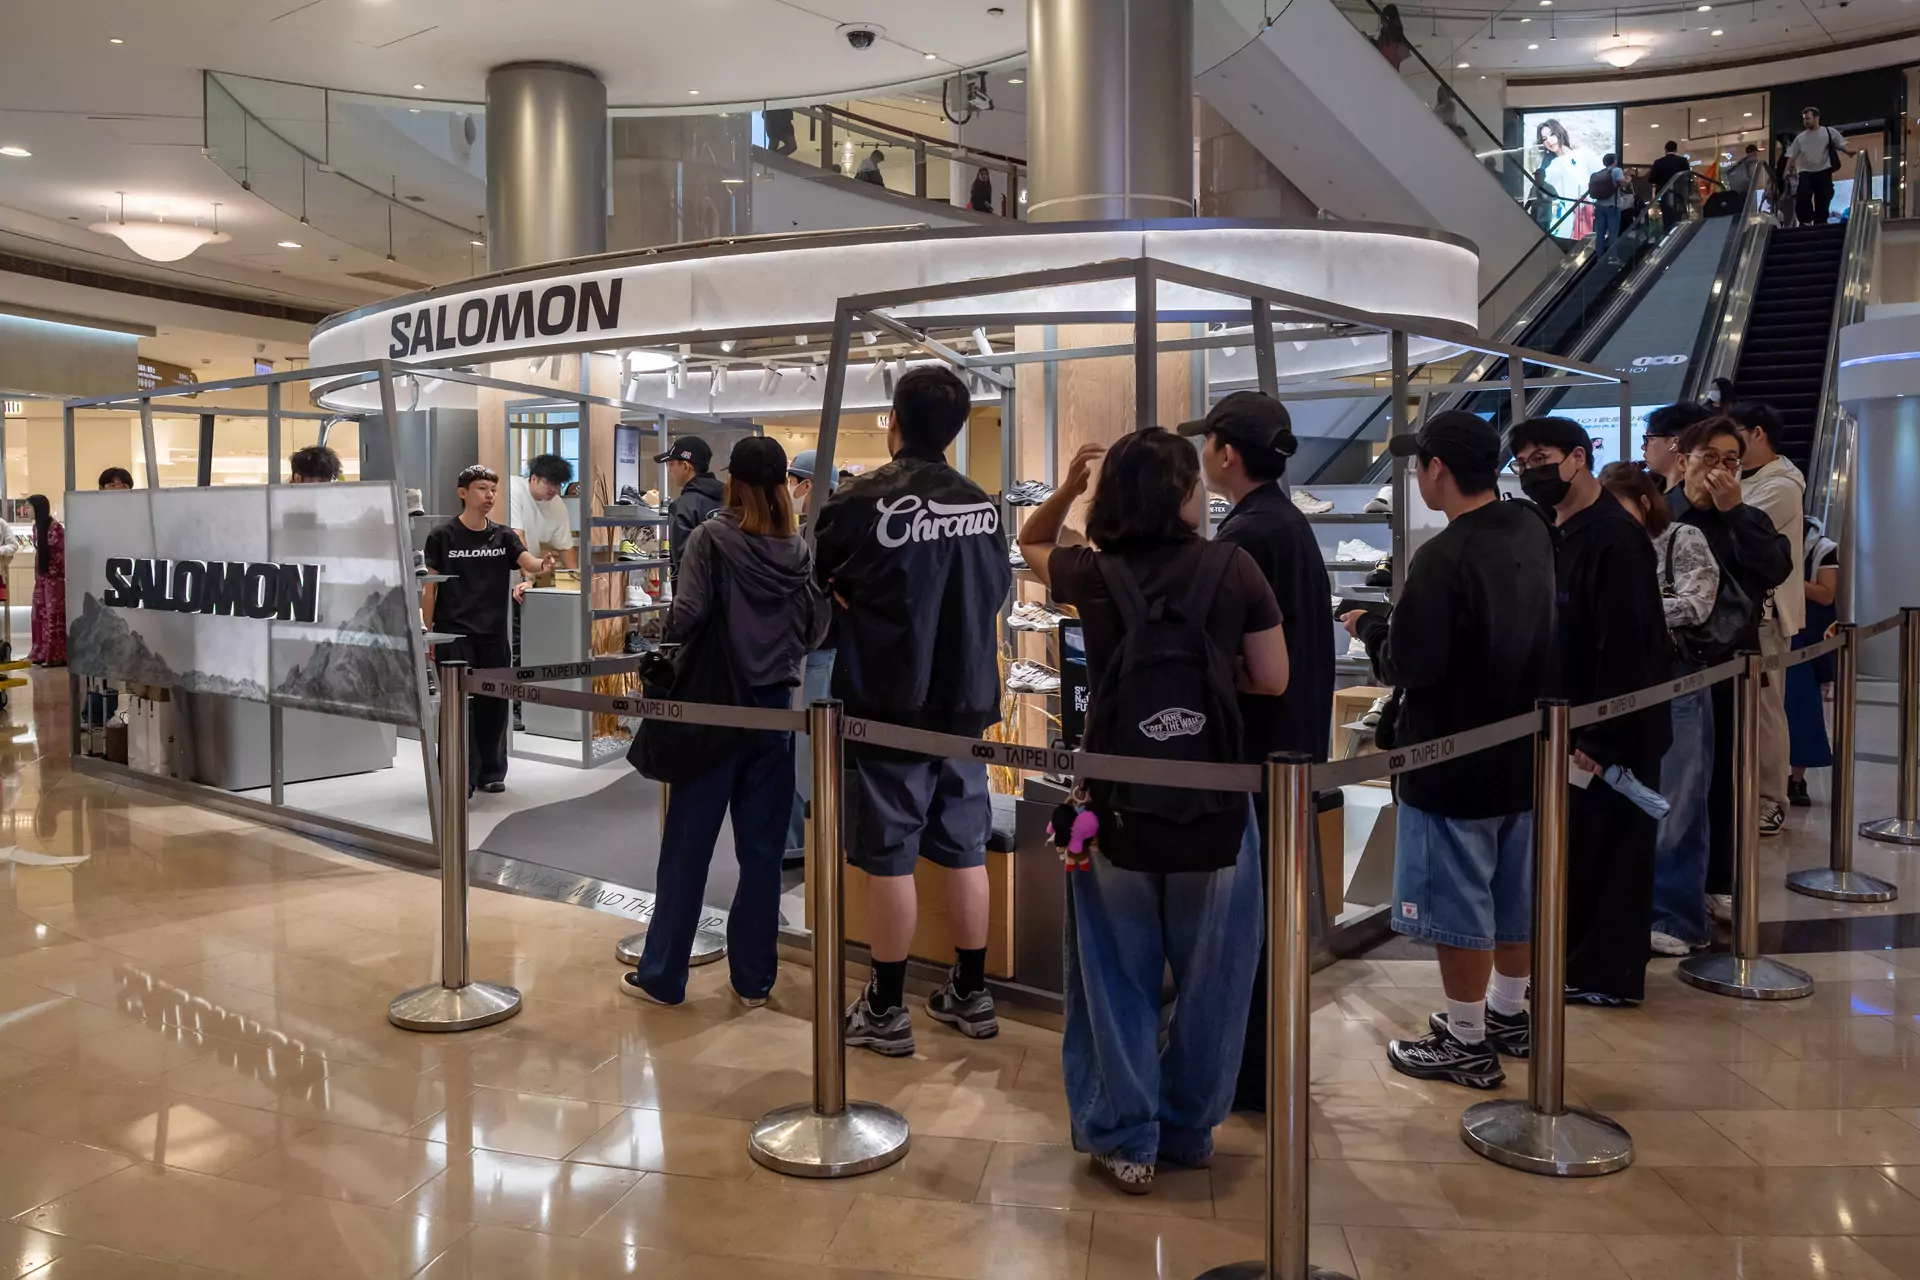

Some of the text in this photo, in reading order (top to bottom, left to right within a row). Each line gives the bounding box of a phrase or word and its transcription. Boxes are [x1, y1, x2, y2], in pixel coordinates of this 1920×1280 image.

[389, 278, 623, 359] SALOMON
[876, 494, 999, 548] Chronic
[448, 547, 506, 558] SALOMON
[104, 557, 321, 623] SALOMON
[541, 665, 573, 679] TAIPEI
[501, 684, 525, 699] TAIPEI
[635, 701, 665, 716] TAIPEI
[1160, 713, 1181, 725] VANS
[1165, 720, 1181, 731] THE
[1002, 746, 1048, 767] TAIPEI
[1410, 740, 1440, 765] TAIPEI
[568, 884, 625, 906] MIND
